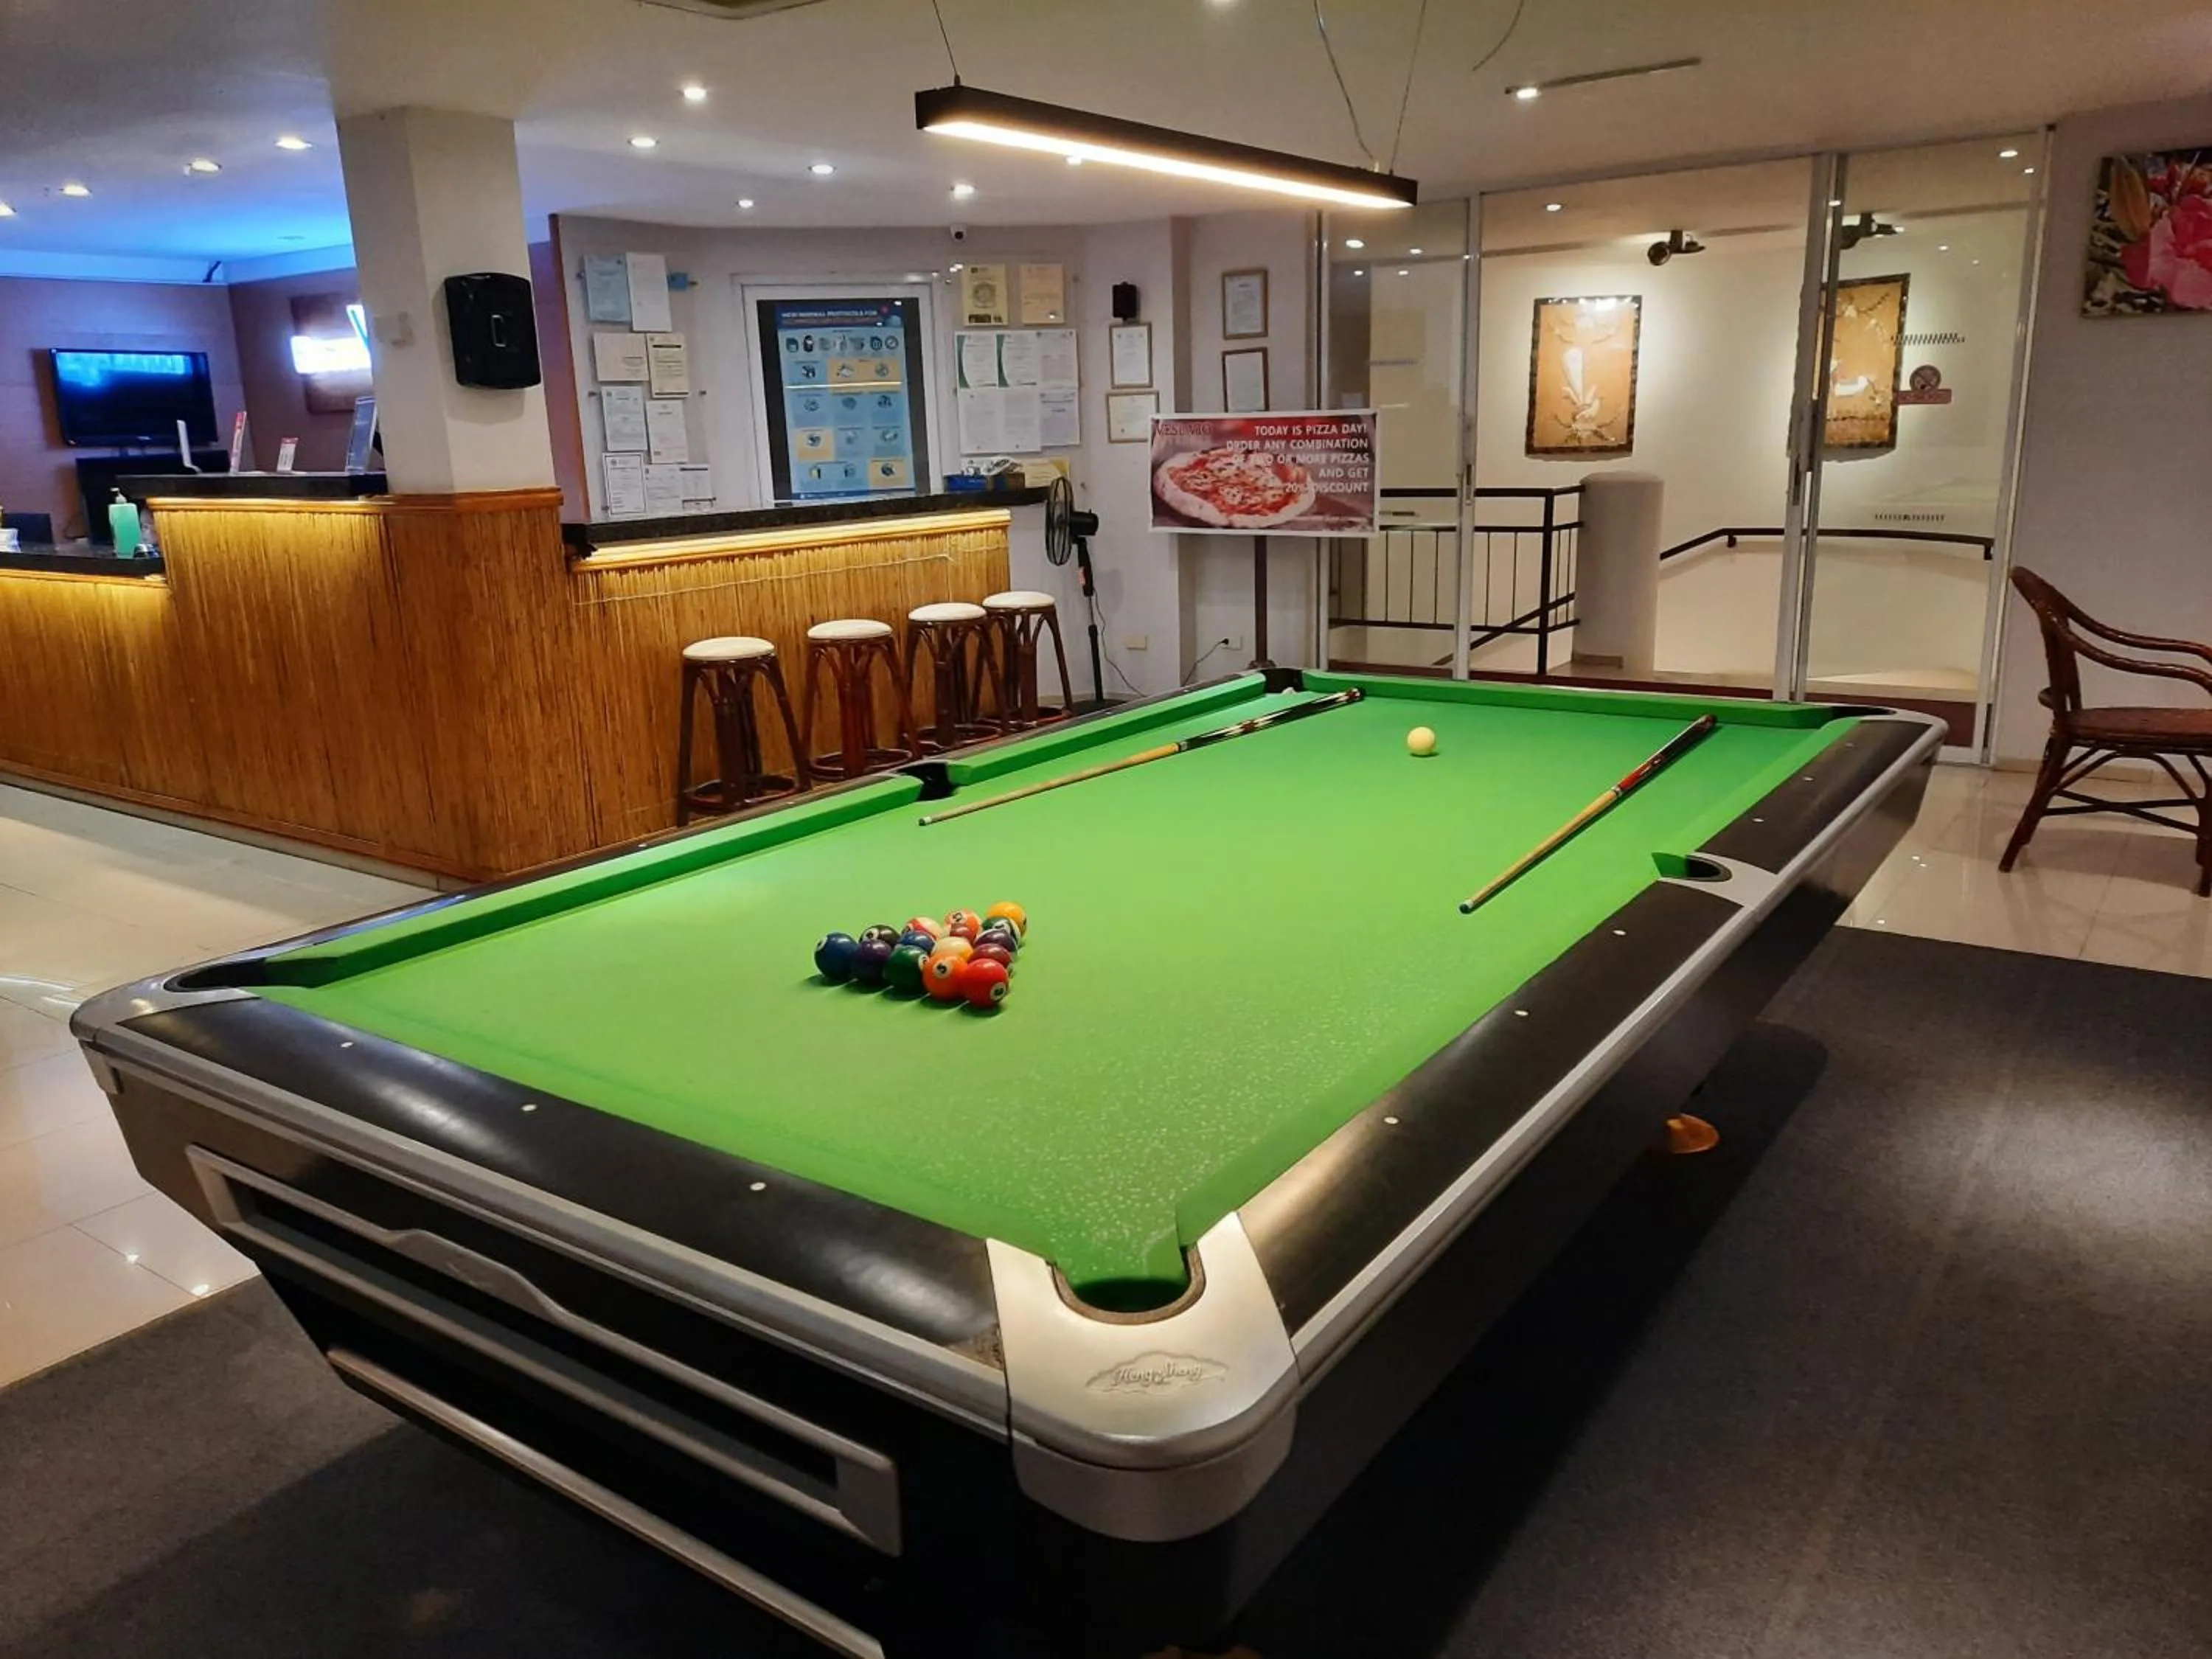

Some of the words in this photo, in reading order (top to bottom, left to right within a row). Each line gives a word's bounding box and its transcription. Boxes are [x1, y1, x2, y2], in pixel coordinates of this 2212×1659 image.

[1254, 425, 1289, 436] TODAY
[1292, 425, 1302, 435] IS
[1306, 424, 1338, 435] PIZZA
[1341, 423, 1367, 434] DAY!
[1226, 439, 1261, 451] ORDER
[1263, 439, 1287, 450] ANY
[1290, 438, 1368, 449] COMBINATION
[1295, 453, 1326, 464] MORE
[1330, 452, 1369, 464] PIZZAS
[1318, 467, 1344, 478] AND
[1348, 467, 1368, 478] GET
[1313, 482, 1368, 493] DISCOUNT
